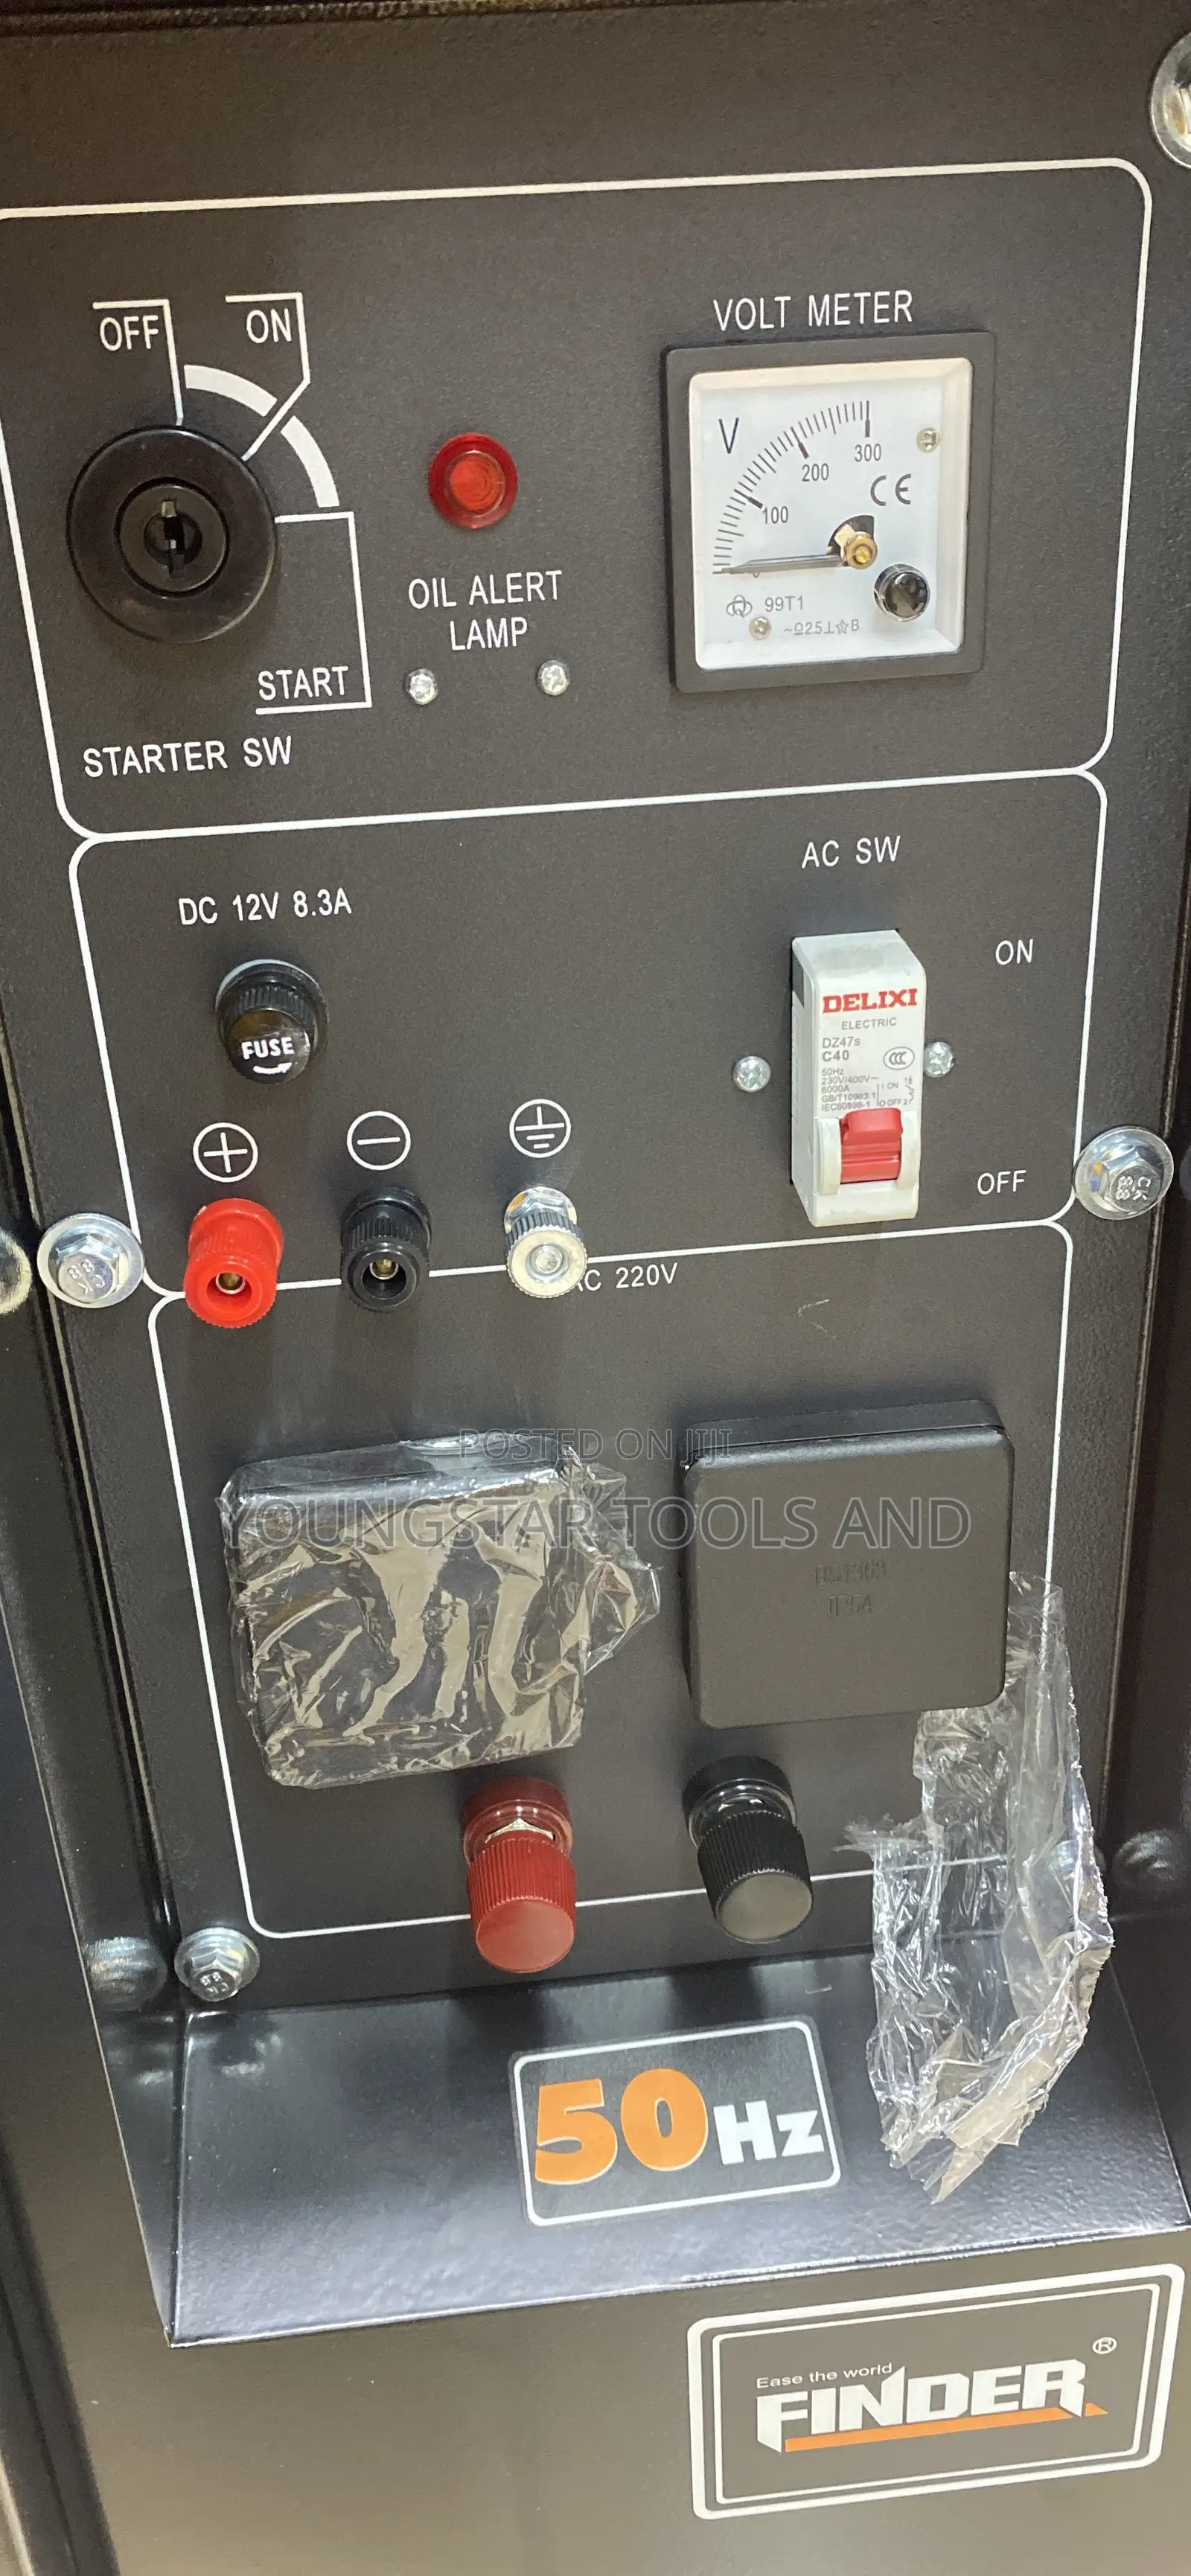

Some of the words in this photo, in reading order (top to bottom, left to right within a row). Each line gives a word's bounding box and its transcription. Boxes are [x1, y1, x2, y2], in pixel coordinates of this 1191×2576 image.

[713, 296, 791, 331] VOLT
[808, 290, 913, 327] METER
[100, 316, 159, 351] OFF
[246, 309, 292, 343] ON
[718, 418, 740, 453] V
[855, 444, 882, 461] 300
[802, 464, 829, 482] 200
[870, 474, 911, 506] CE
[763, 506, 789, 525] 100
[407, 578, 457, 610] OIL
[468, 571, 562, 606] ALERT
[765, 595, 804, 613] 99T1
[450, 617, 528, 651] LAMP
[258, 666, 348, 700] START
[83, 740, 228, 777] STARTER
[243, 735, 292, 767] SW
[802, 840, 839, 869] AC
[855, 835, 901, 864] SW
[178, 897, 217, 926] DC
[233, 892, 278, 921] 12V
[293, 888, 352, 917] 8.3A
[995, 939, 1034, 965] ON
[822, 988, 918, 1014] DELIXI
[841, 1017, 897, 1030] ELECTRIC
[241, 1036, 295, 1060] FUSE
[822, 1037, 860, 1049] DZ47s
[822, 1050, 849, 1062] C40
[822, 1067, 844, 1076] 50Hz
[821, 1085, 850, 1093] 6000A
[887, 1081, 898, 1090] ON
[977, 1170, 1026, 1195] OFF
[616, 1262, 677, 1288] 220V
[756, 2375, 803, 2389] Ease
[808, 2371, 837, 2383] the
[843, 2362, 893, 2380] world
[756, 2359, 1086, 2452] FINDER
